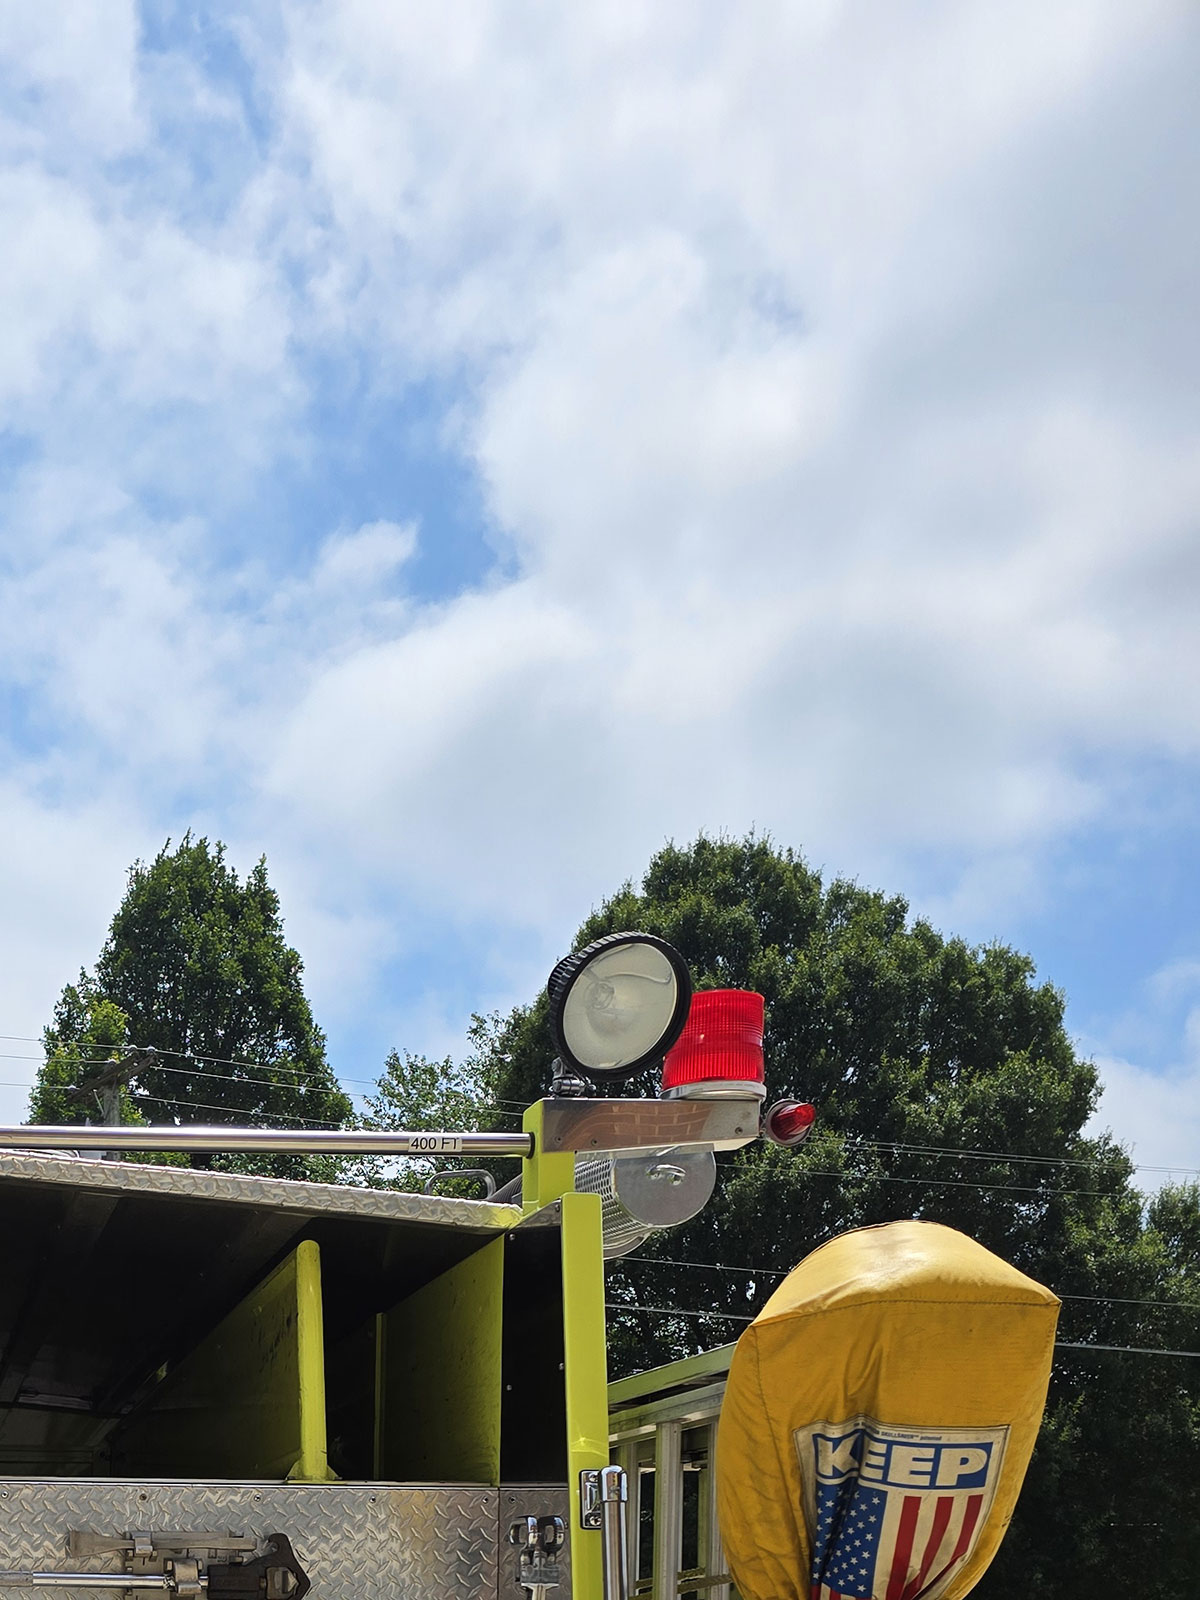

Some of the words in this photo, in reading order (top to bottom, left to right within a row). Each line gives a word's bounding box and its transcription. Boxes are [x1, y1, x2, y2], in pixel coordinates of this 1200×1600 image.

[411, 1137, 437, 1150] 400
[441, 1138, 460, 1150] FT
[816, 1433, 988, 1486] KEEP
